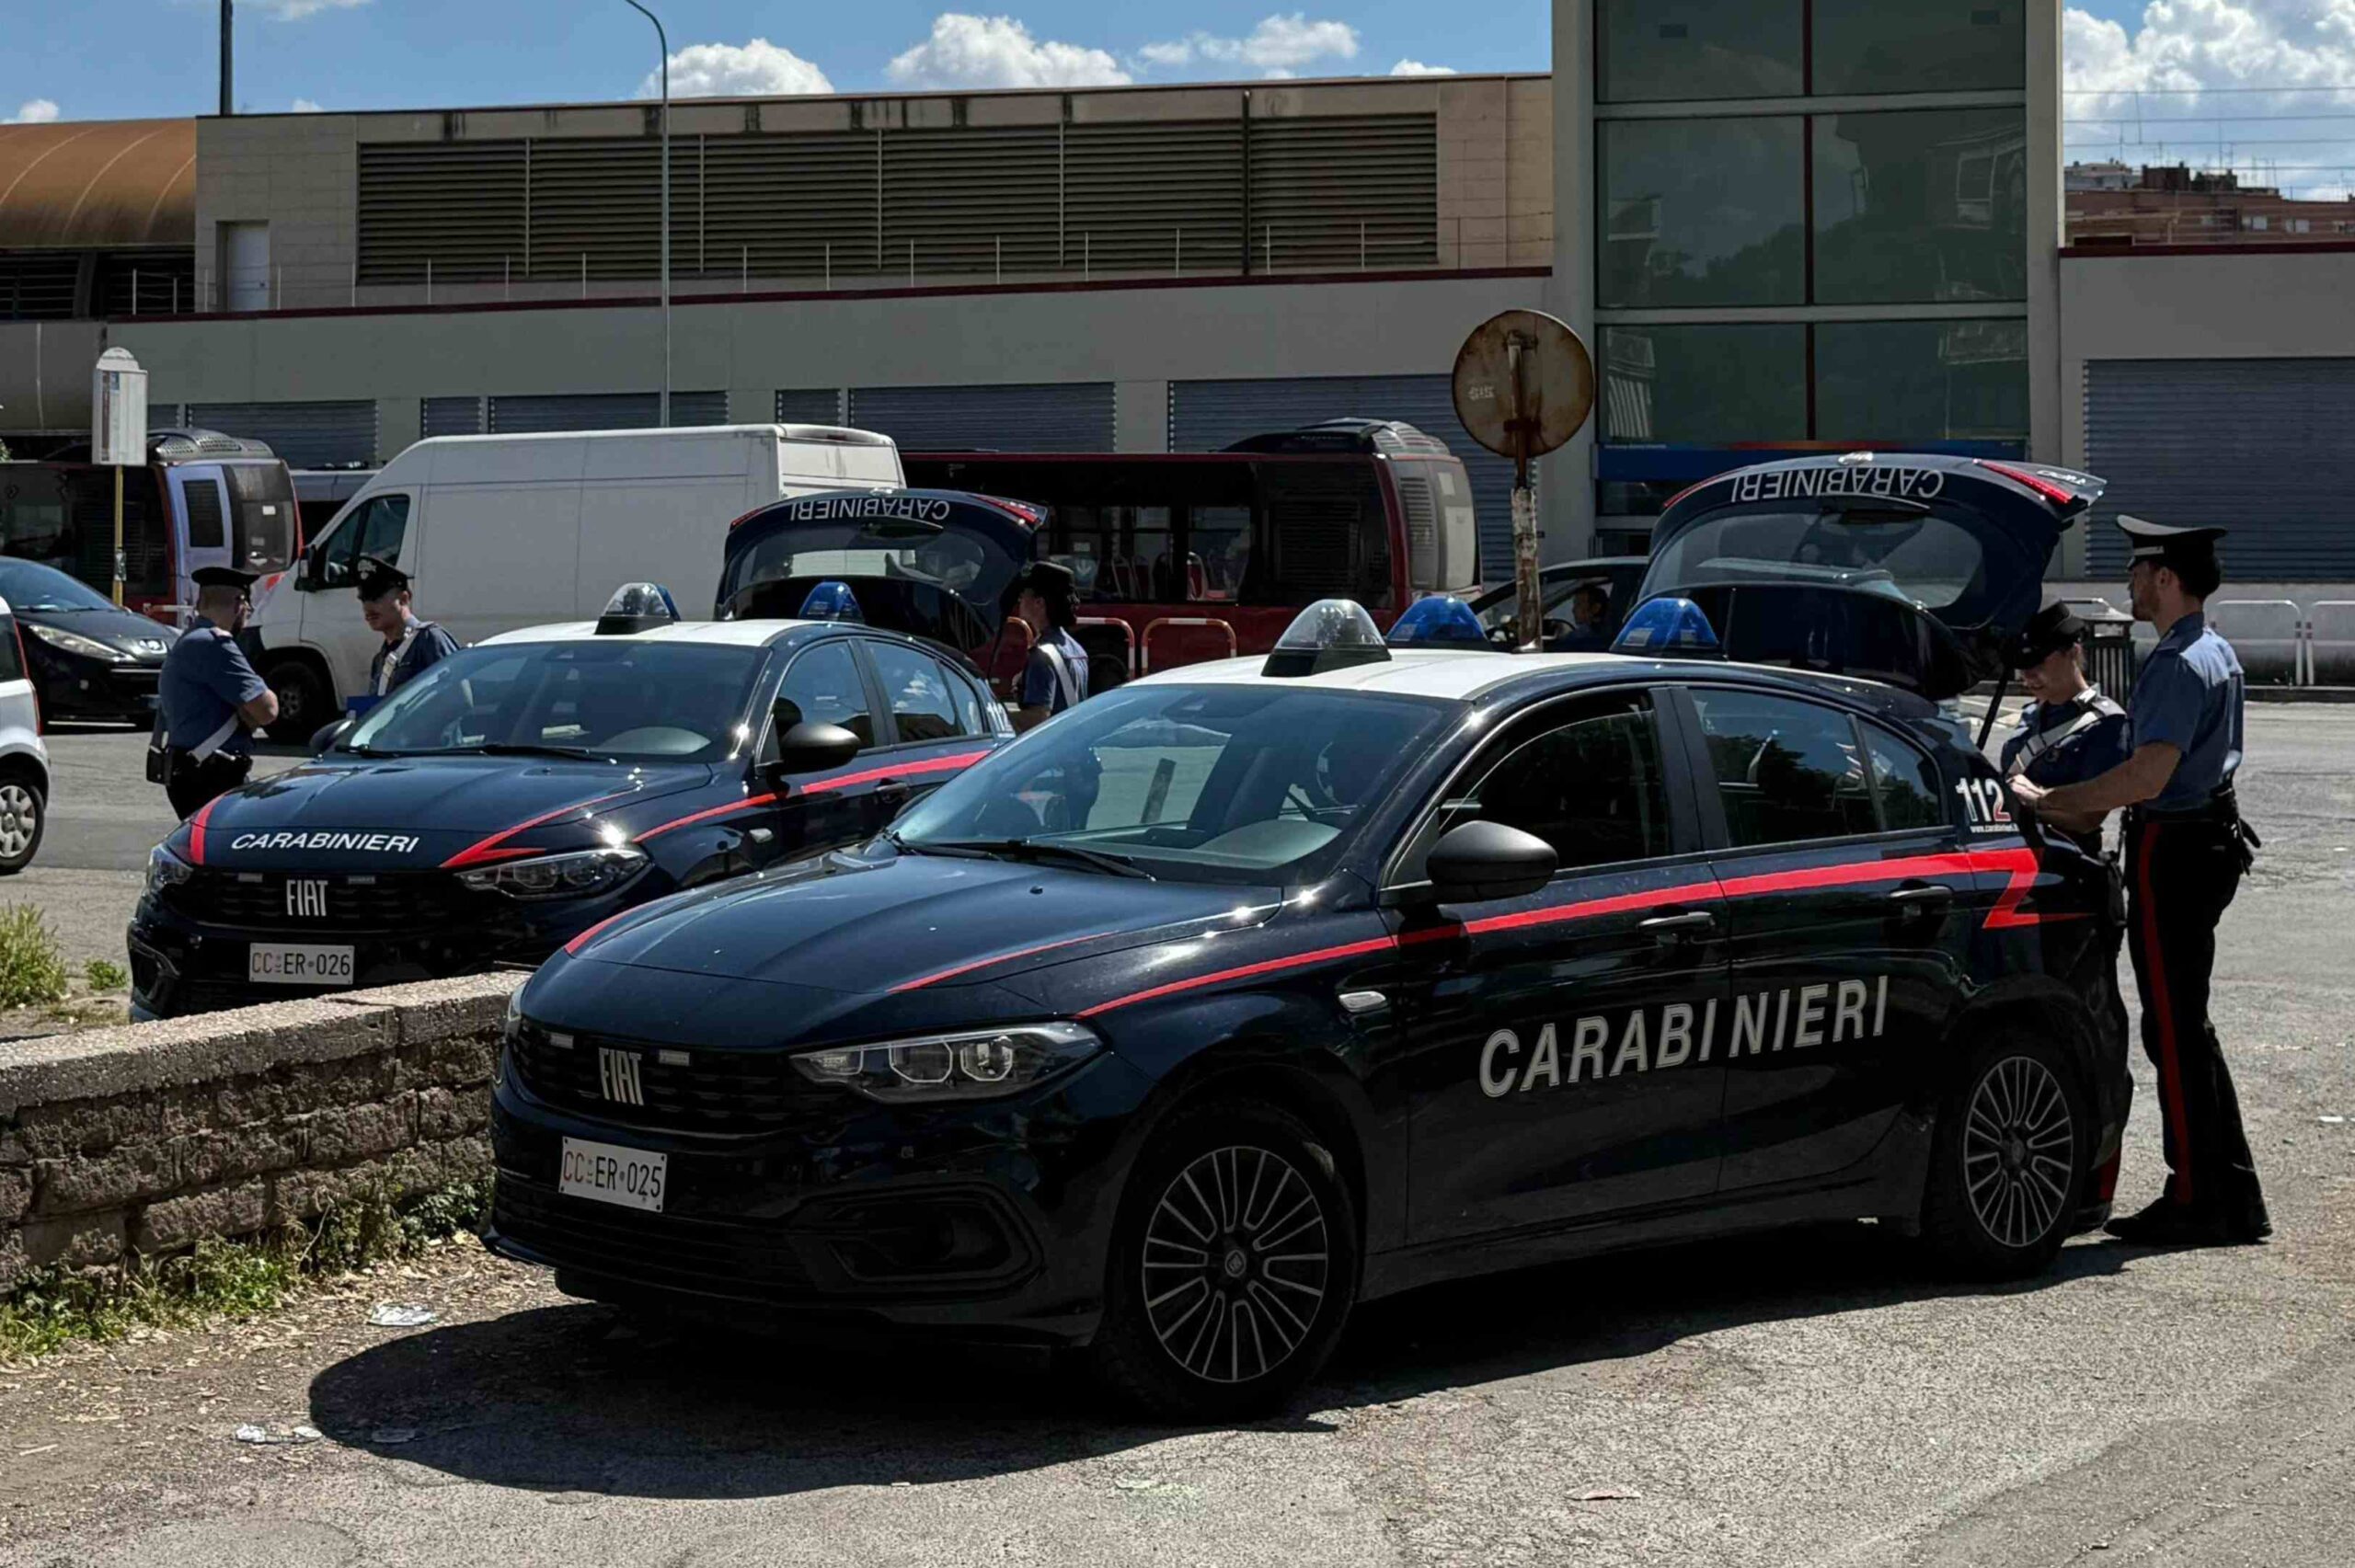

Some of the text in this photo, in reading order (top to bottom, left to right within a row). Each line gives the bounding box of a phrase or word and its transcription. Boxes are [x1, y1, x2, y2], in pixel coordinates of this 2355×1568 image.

[1730, 467, 1945, 502] CARABINIERI
[790, 498, 950, 521] CARABINIERI
[986, 701, 1014, 732] 112
[1955, 777, 2012, 822] 112
[231, 832, 419, 853] CARABINIERI
[286, 879, 328, 917] FIAT
[1478, 975, 1889, 1098] CARABINIERI
[598, 1047, 644, 1106] FIAT
